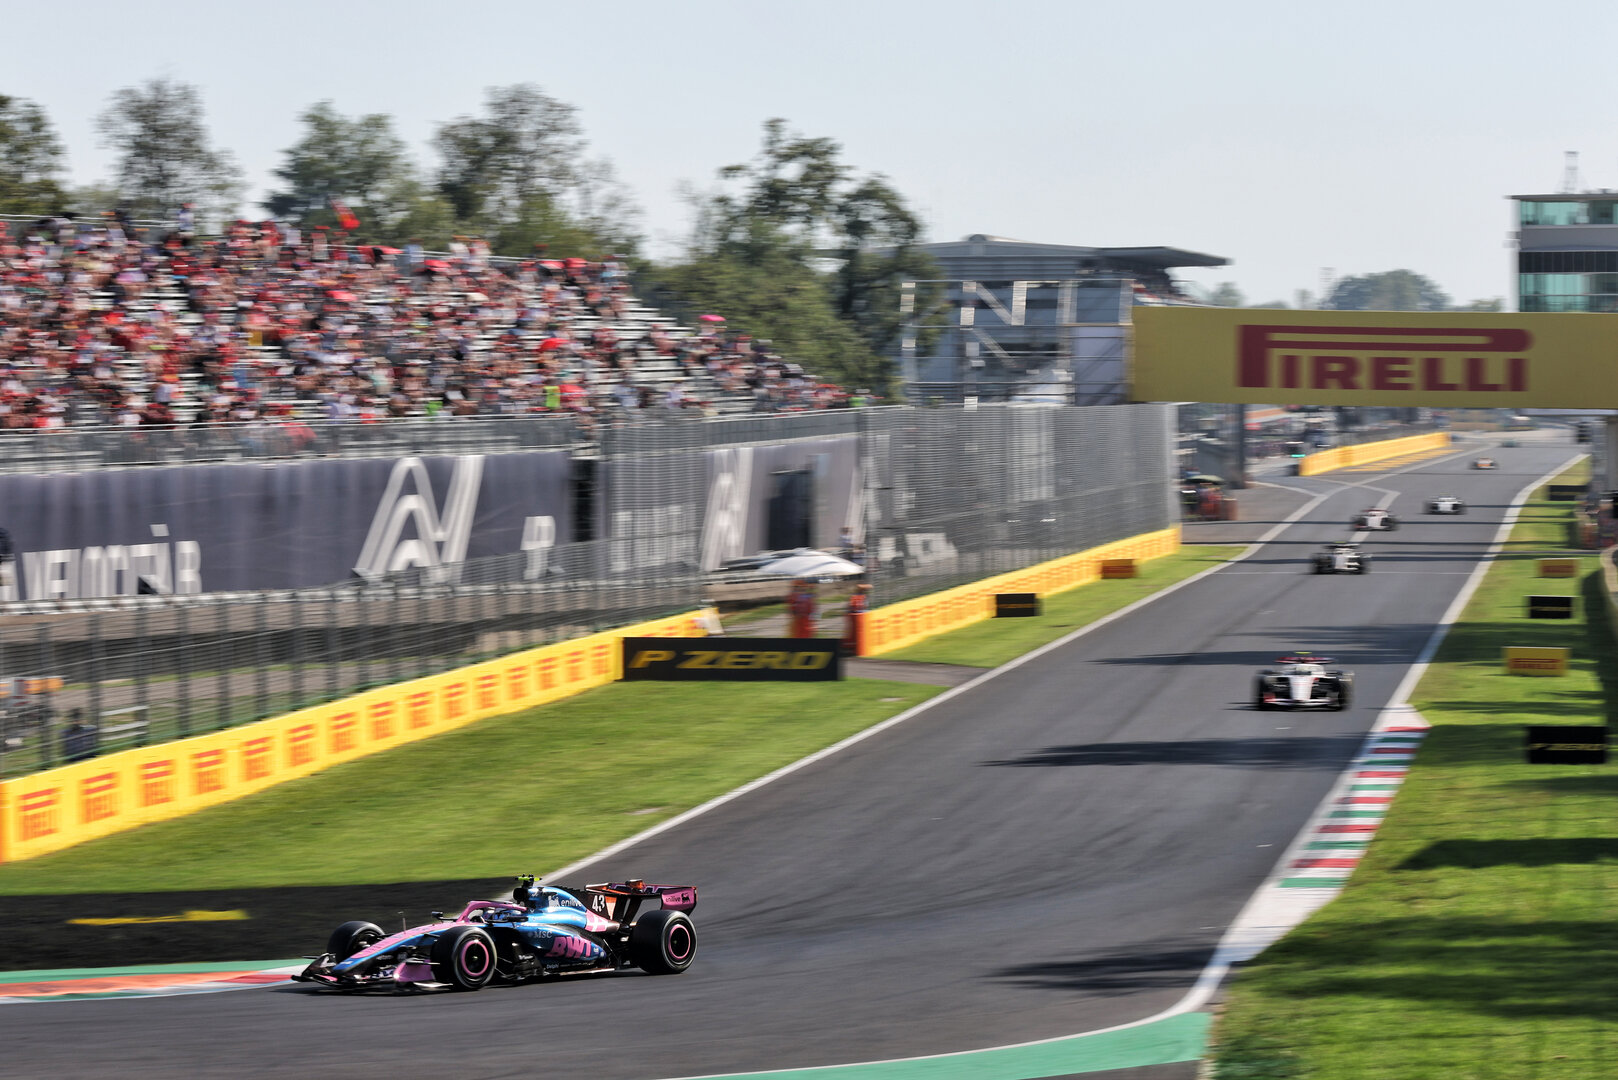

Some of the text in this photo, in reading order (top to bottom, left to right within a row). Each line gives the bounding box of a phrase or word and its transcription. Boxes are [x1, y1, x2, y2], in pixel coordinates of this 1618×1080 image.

[1237, 324, 1534, 392] PIRELLI
[628, 650, 676, 669] P
[676, 651, 834, 670] ZERO
[592, 895, 605, 912] 43
[533, 930, 553, 939] MSC
[544, 936, 592, 959] BWT
